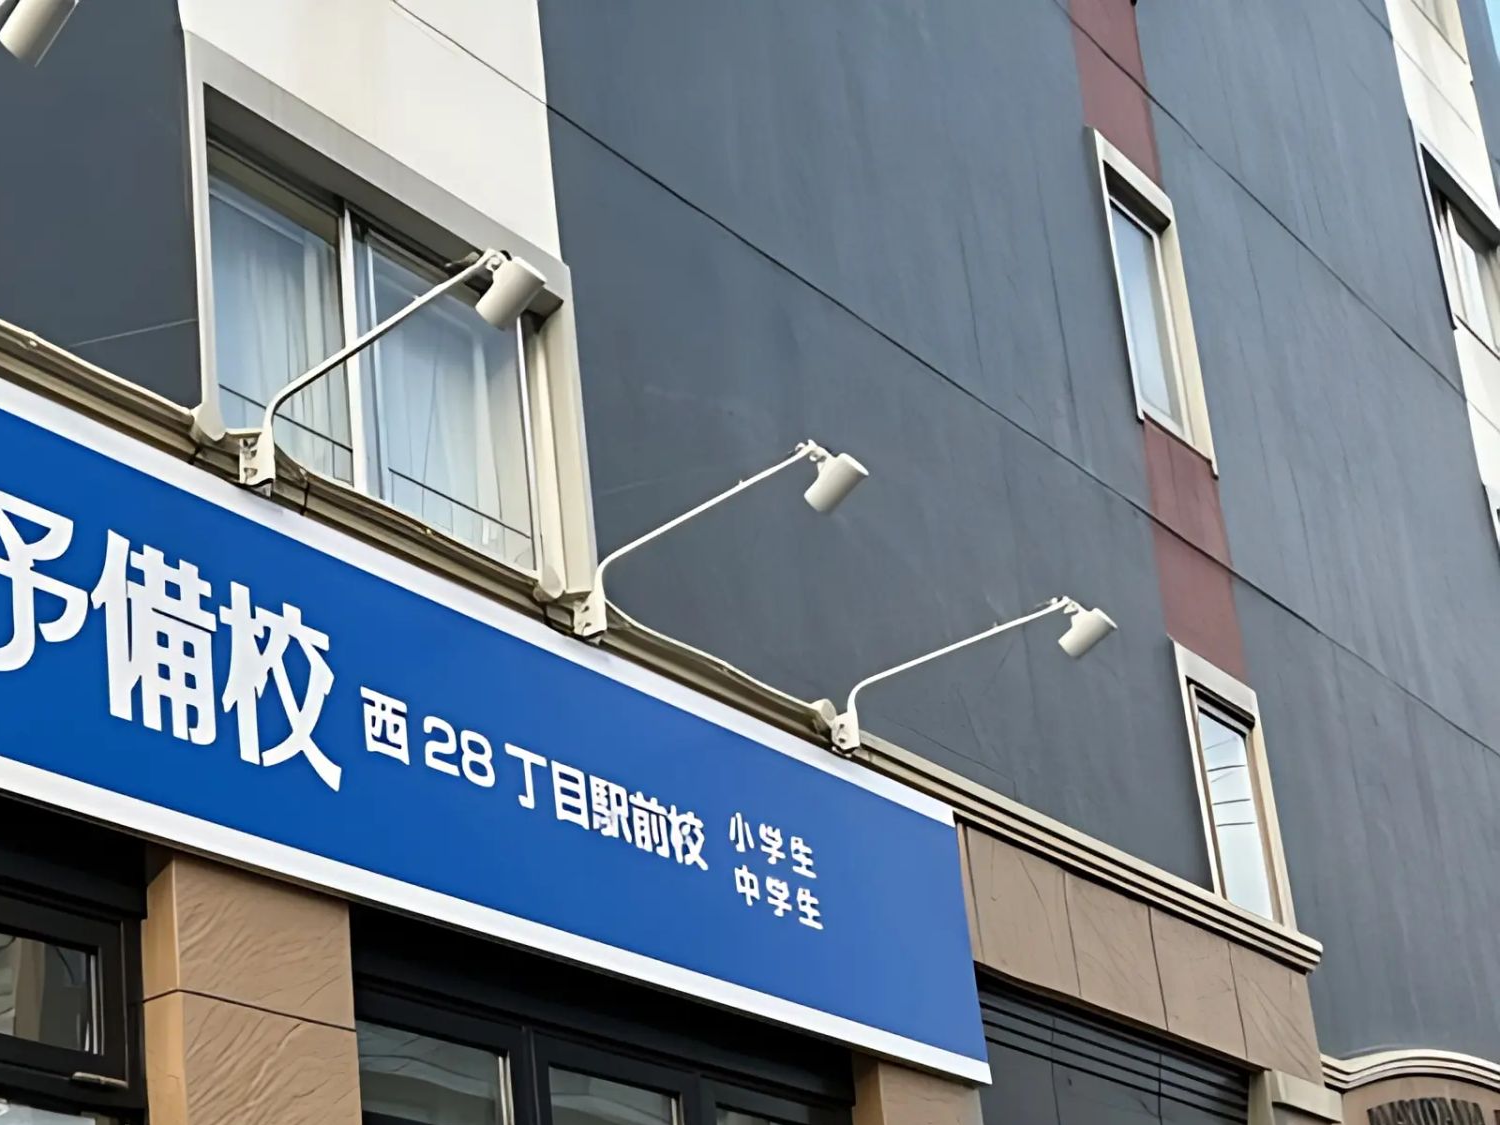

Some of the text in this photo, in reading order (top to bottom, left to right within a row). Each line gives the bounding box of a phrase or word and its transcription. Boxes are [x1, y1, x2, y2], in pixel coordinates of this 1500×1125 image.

[360, 686, 708, 871] 西28丁目駅前校
[729, 812, 817, 879] 小学生
[734, 865, 824, 930] 中学生
